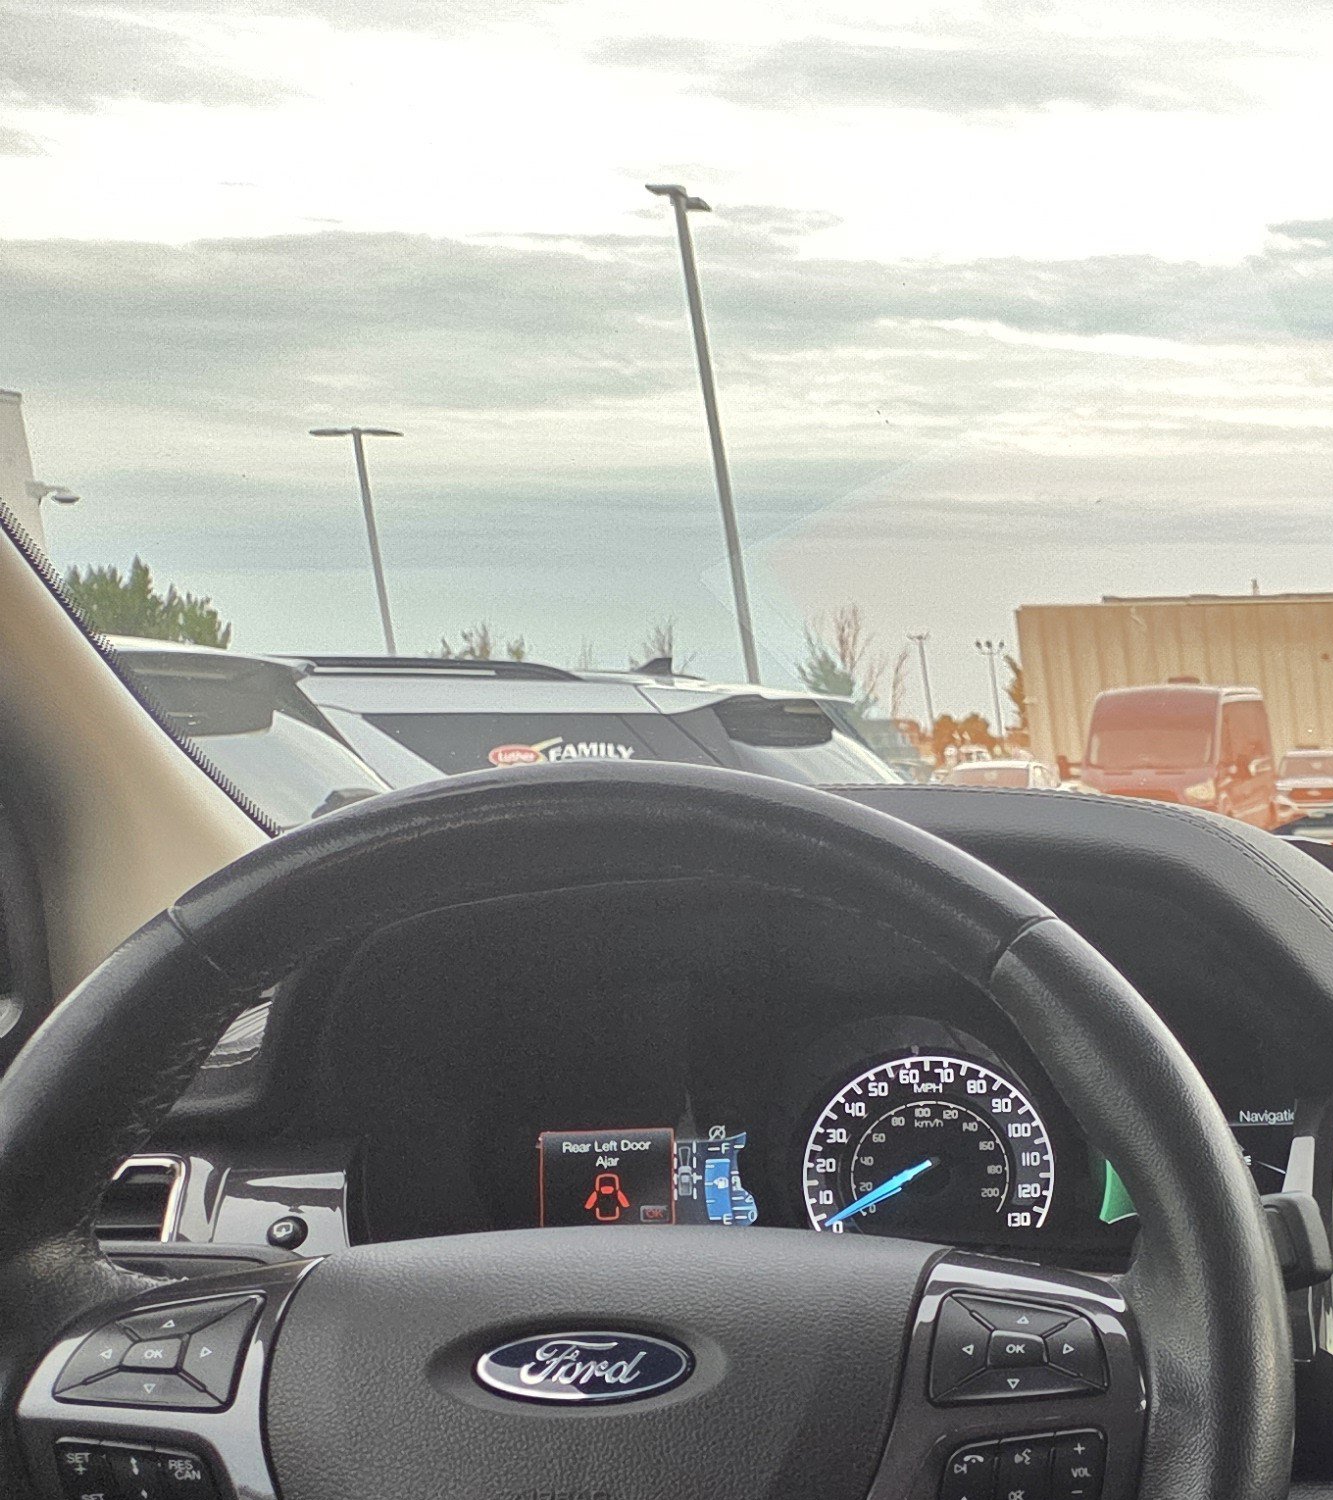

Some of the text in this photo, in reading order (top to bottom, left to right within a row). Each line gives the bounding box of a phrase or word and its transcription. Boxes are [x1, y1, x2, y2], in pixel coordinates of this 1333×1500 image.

[549, 742, 635, 762] FAMILY
[900, 1069, 919, 1084] 60
[935, 1068, 954, 1083] 70
[868, 1082, 888, 1097] 50
[914, 1083, 943, 1093] MPH
[967, 1079, 987, 1094] 80
[845, 1102, 865, 1117] 40
[991, 1098, 1012, 1113] 90
[826, 1128, 846, 1143] 30
[1008, 1123, 1031, 1137] 100
[562, 1139, 652, 1154] Rear Left Door
[596, 1155, 620, 1169] Ajar
[816, 1158, 836, 1172] 20
[1022, 1152, 1040, 1166] 110
[819, 1190, 833, 1204] 10
[1018, 1184, 1040, 1198] 120
[1008, 1212, 1030, 1227] 130
[144, 1349, 163, 1359] OK
[1005, 1344, 1026, 1354] OK
[520, 1340, 647, 1385] Ford
[65, 1452, 91, 1463] SET
[168, 1460, 193, 1470] RES
[174, 1470, 201, 1480] CAN
[1071, 1468, 1091, 1478] VOL
